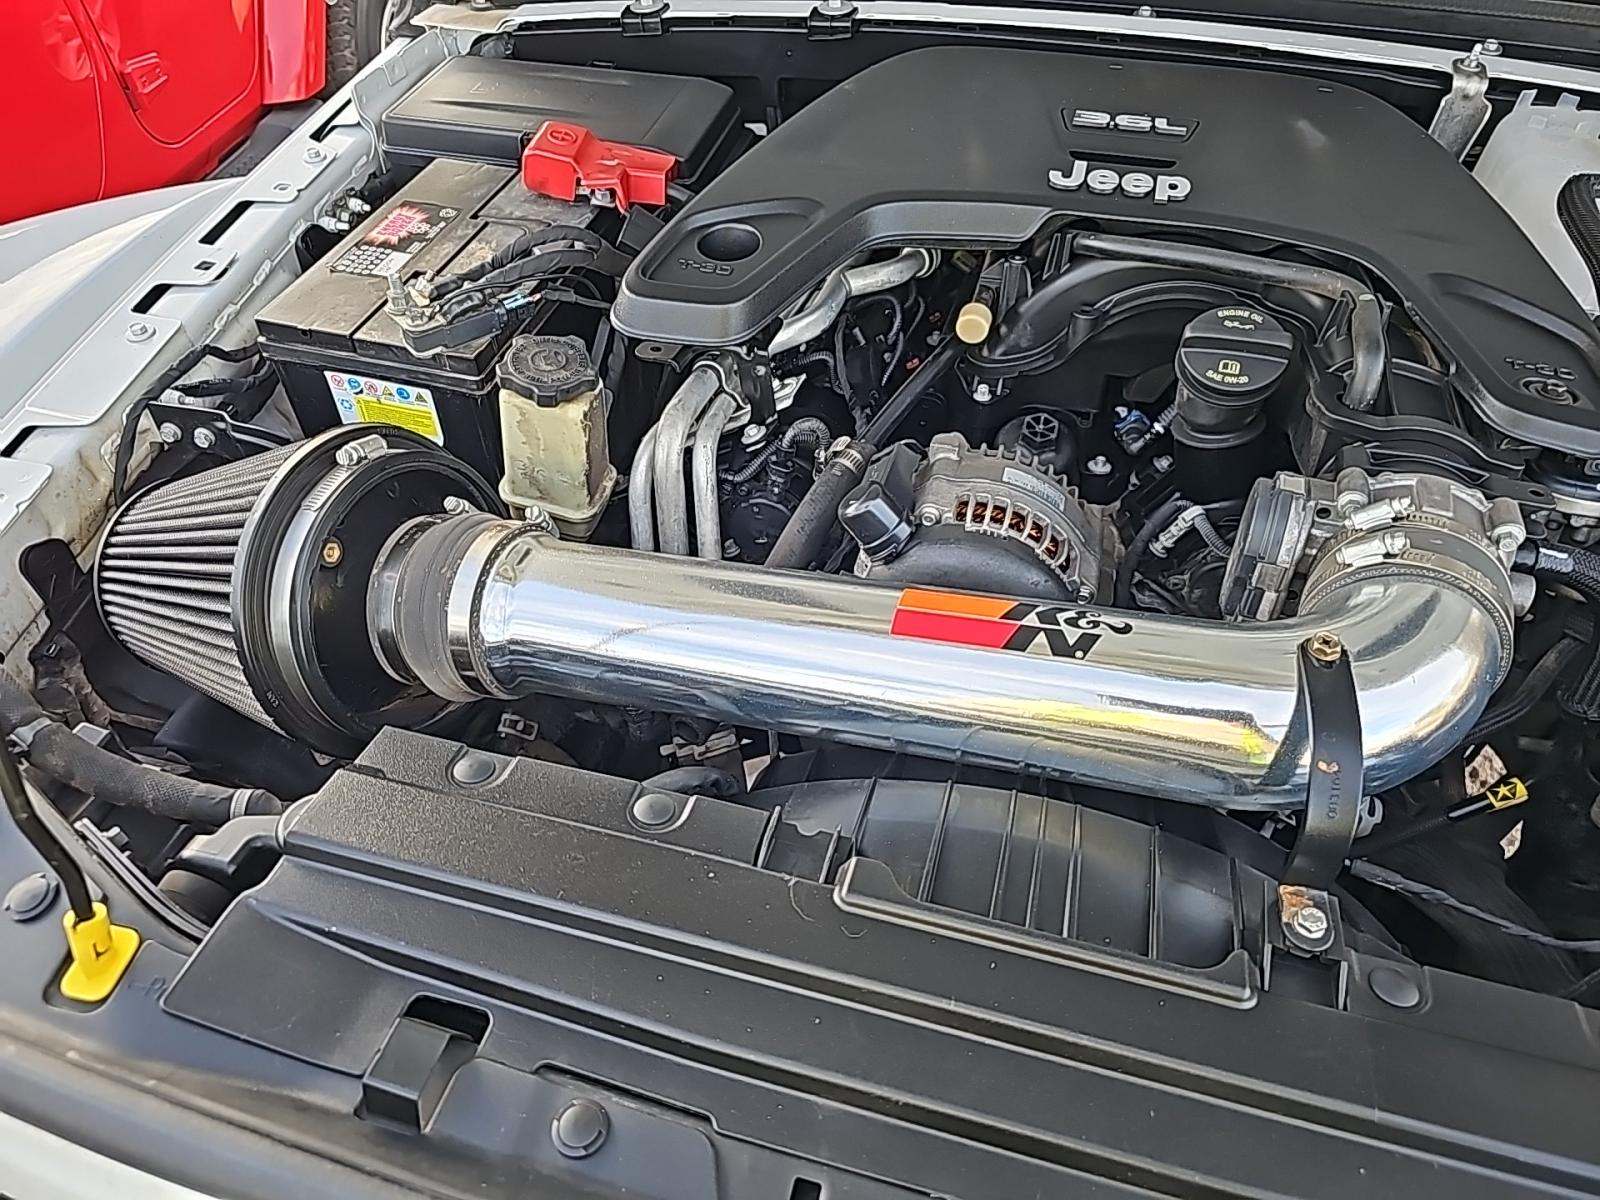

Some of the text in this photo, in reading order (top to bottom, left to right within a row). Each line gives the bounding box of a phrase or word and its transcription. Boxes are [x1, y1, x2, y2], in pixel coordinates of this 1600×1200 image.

[1072, 109, 1188, 136] 3.6L
[1048, 159, 1192, 205] Jeep
[1217, 309, 1264, 324] ENGINE OIL
[1205, 369, 1224, 382] SAE
[1001, 602, 1133, 660] K&N
